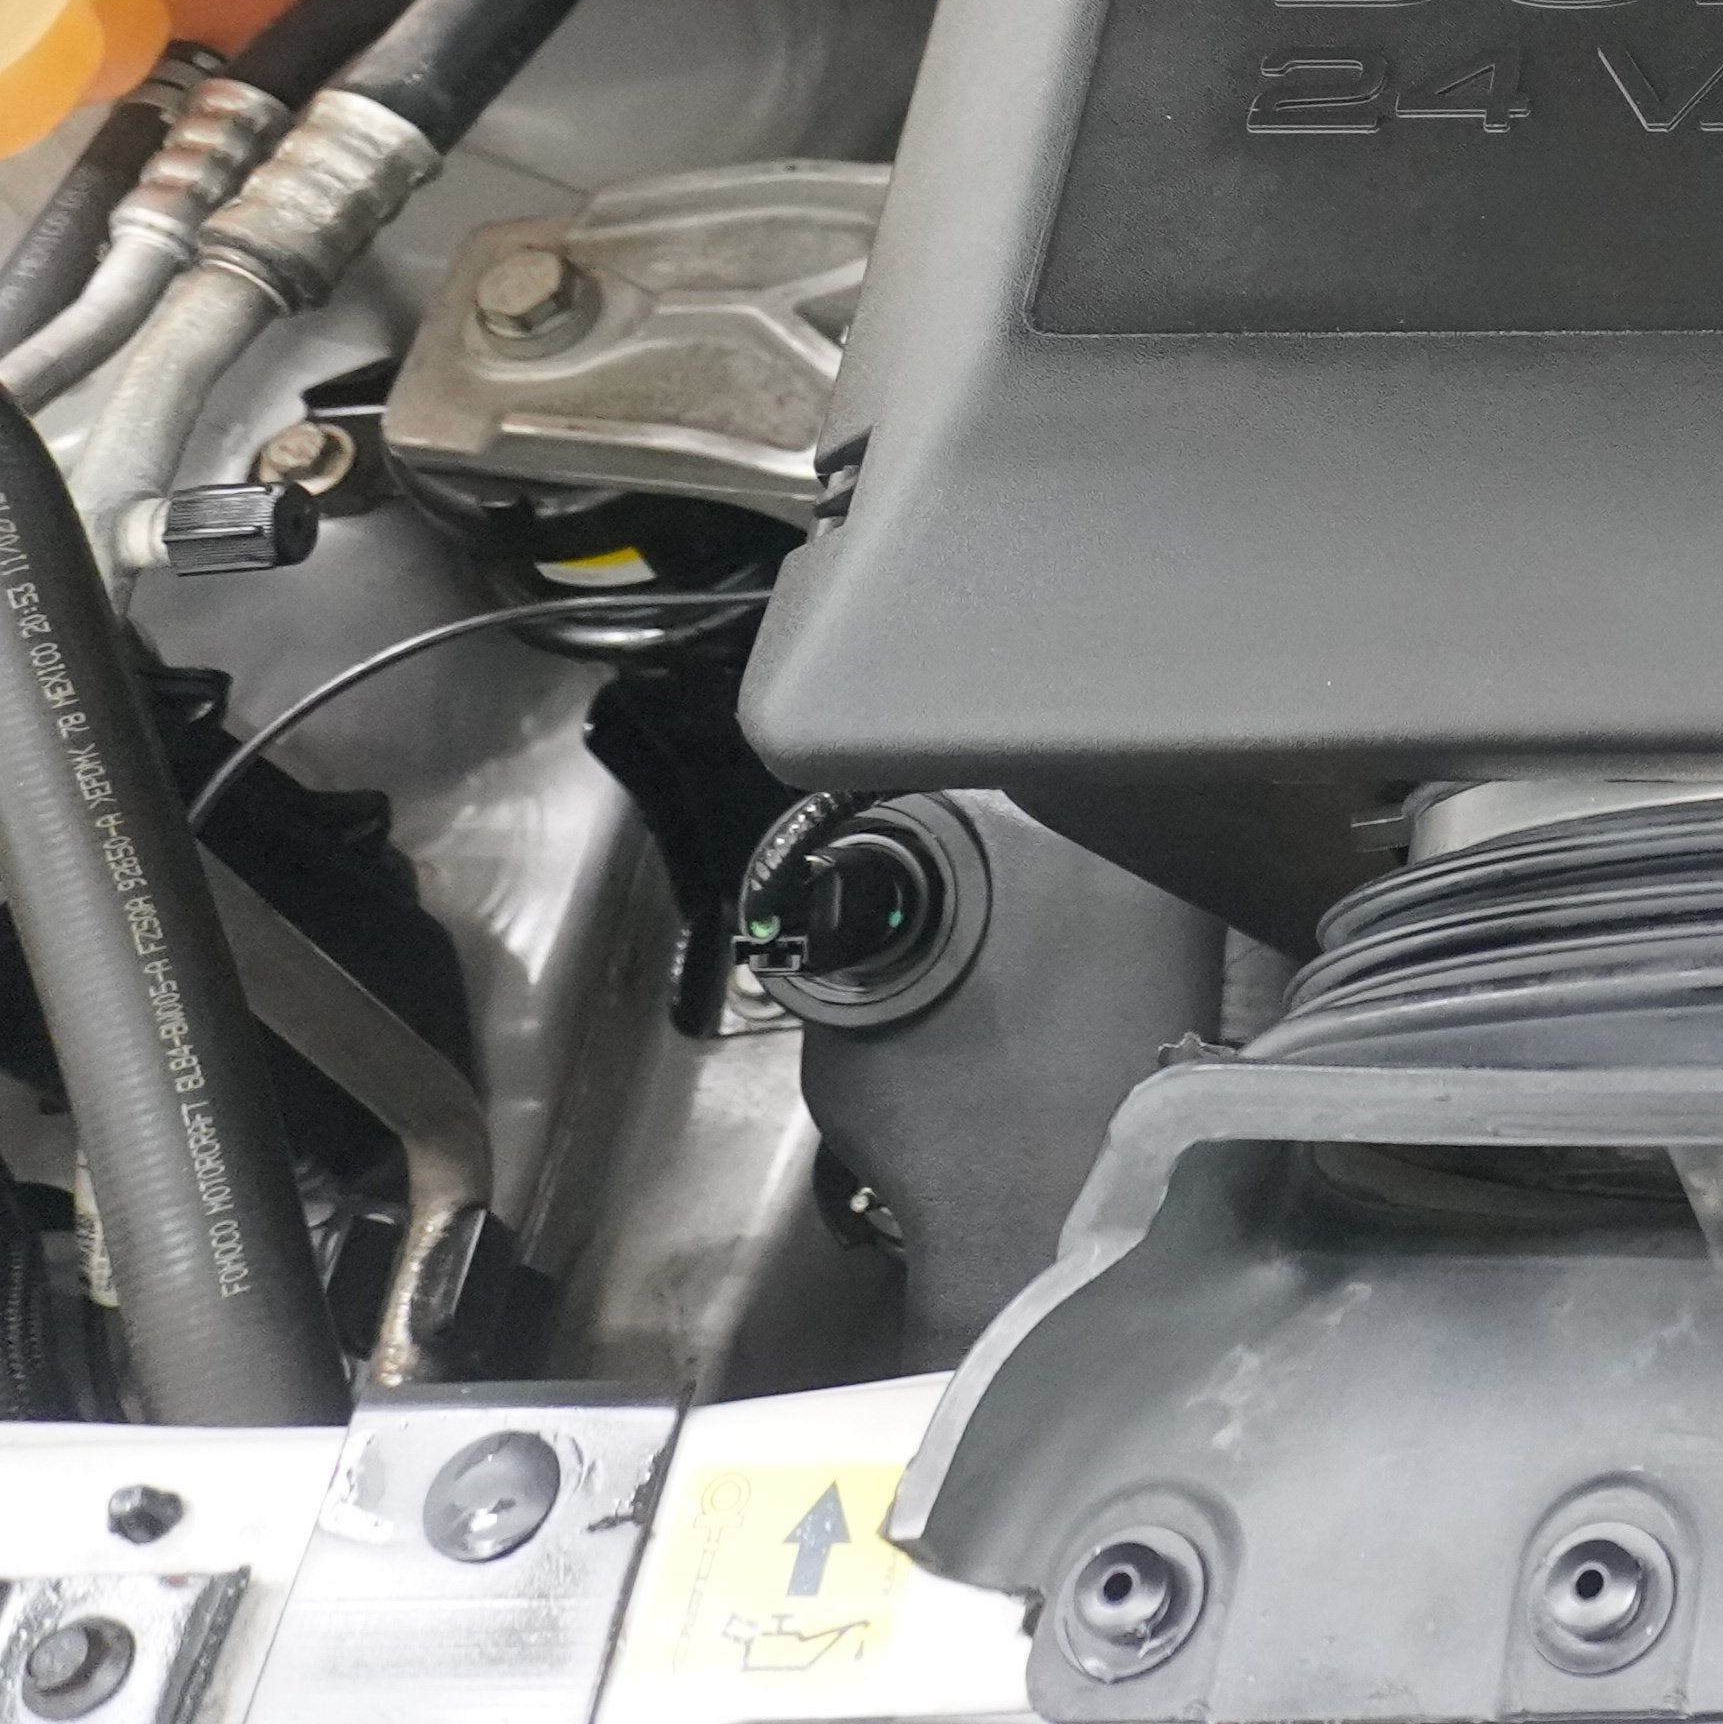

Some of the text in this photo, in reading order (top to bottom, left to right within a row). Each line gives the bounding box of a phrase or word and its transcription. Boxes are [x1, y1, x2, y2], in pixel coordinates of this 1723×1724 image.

[1247, 45, 1532, 133] 24
[7, 581, 52, 639] 20:53
[30, 641, 79, 709] MEXICO
[180, 1100, 235, 1216] MOTORCRAFT
[208, 1219, 251, 1299] FOMOCO
